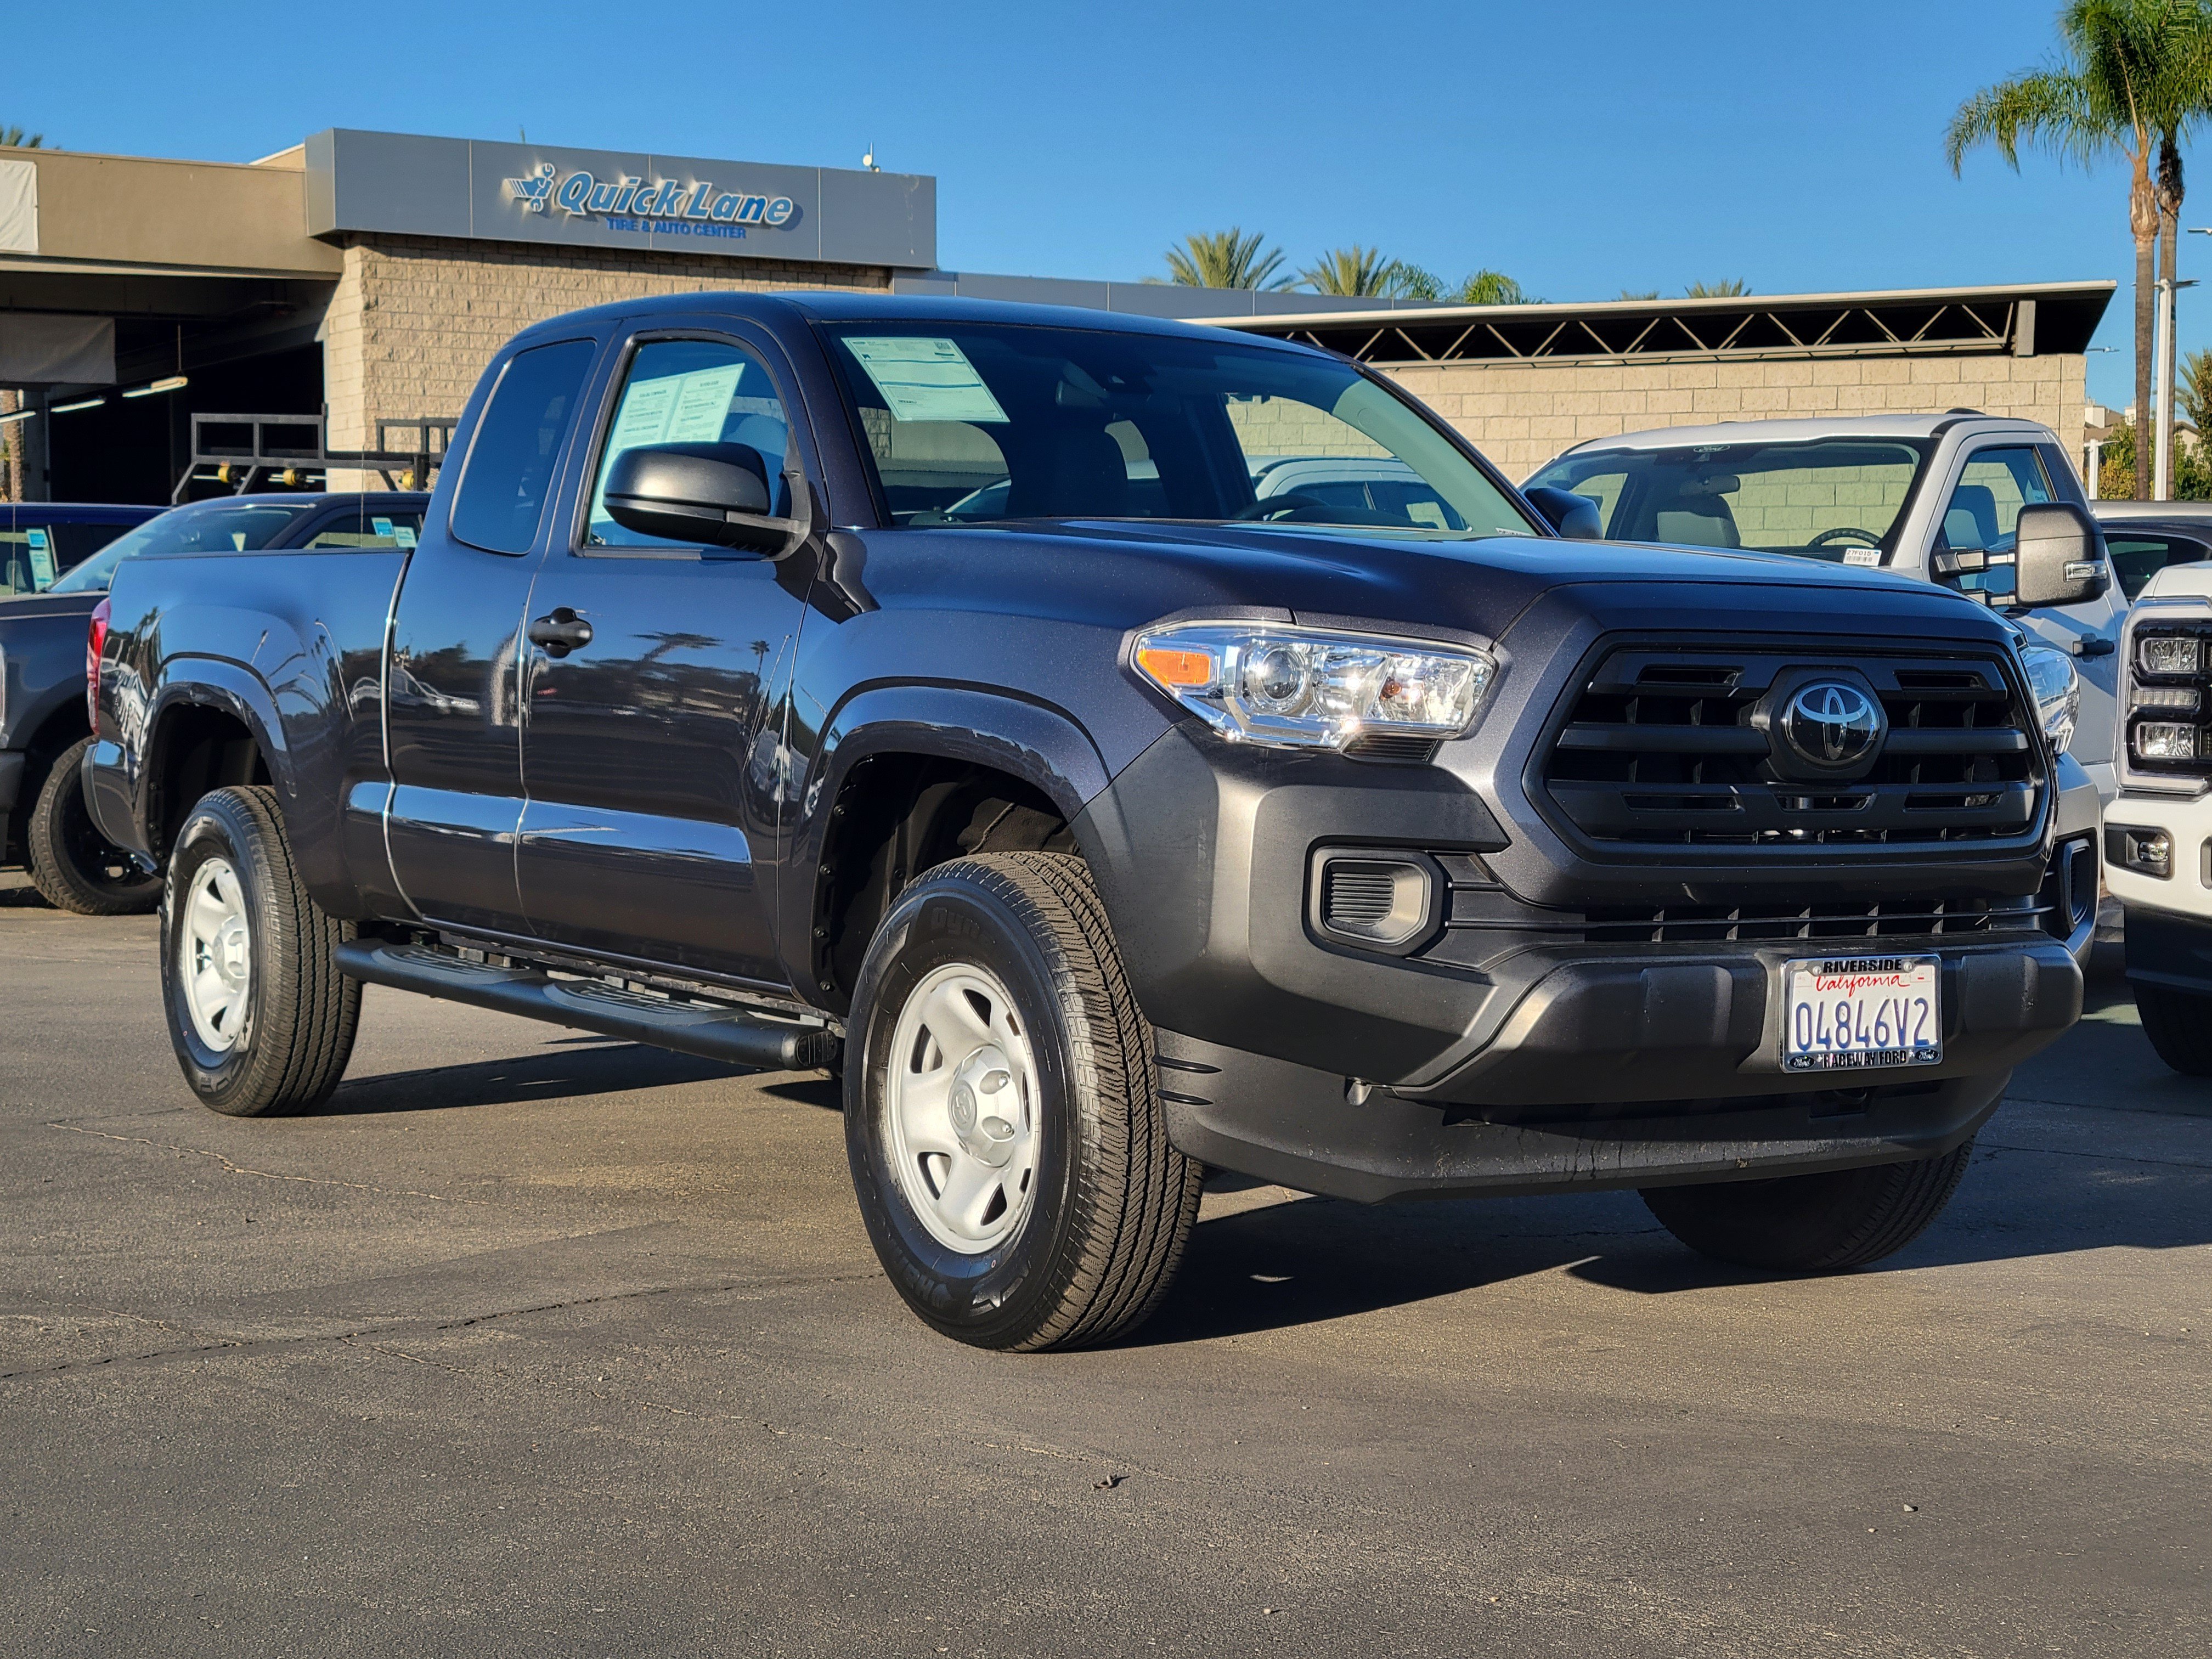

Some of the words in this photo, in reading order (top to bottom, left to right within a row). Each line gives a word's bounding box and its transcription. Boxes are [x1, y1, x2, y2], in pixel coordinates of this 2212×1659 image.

[605, 217, 639, 232] TIRE
[641, 220, 651, 232] &
[653, 221, 691, 235] AUTO
[692, 223, 746, 239] CENTER
[1822, 959, 1902, 973] RIVERSIDE
[1816, 974, 1910, 997] California
[1796, 997, 1929, 1052] 04846V2
[1822, 1052, 1876, 1069] RACEWAY
[1878, 1049, 1907, 1065] FORD
